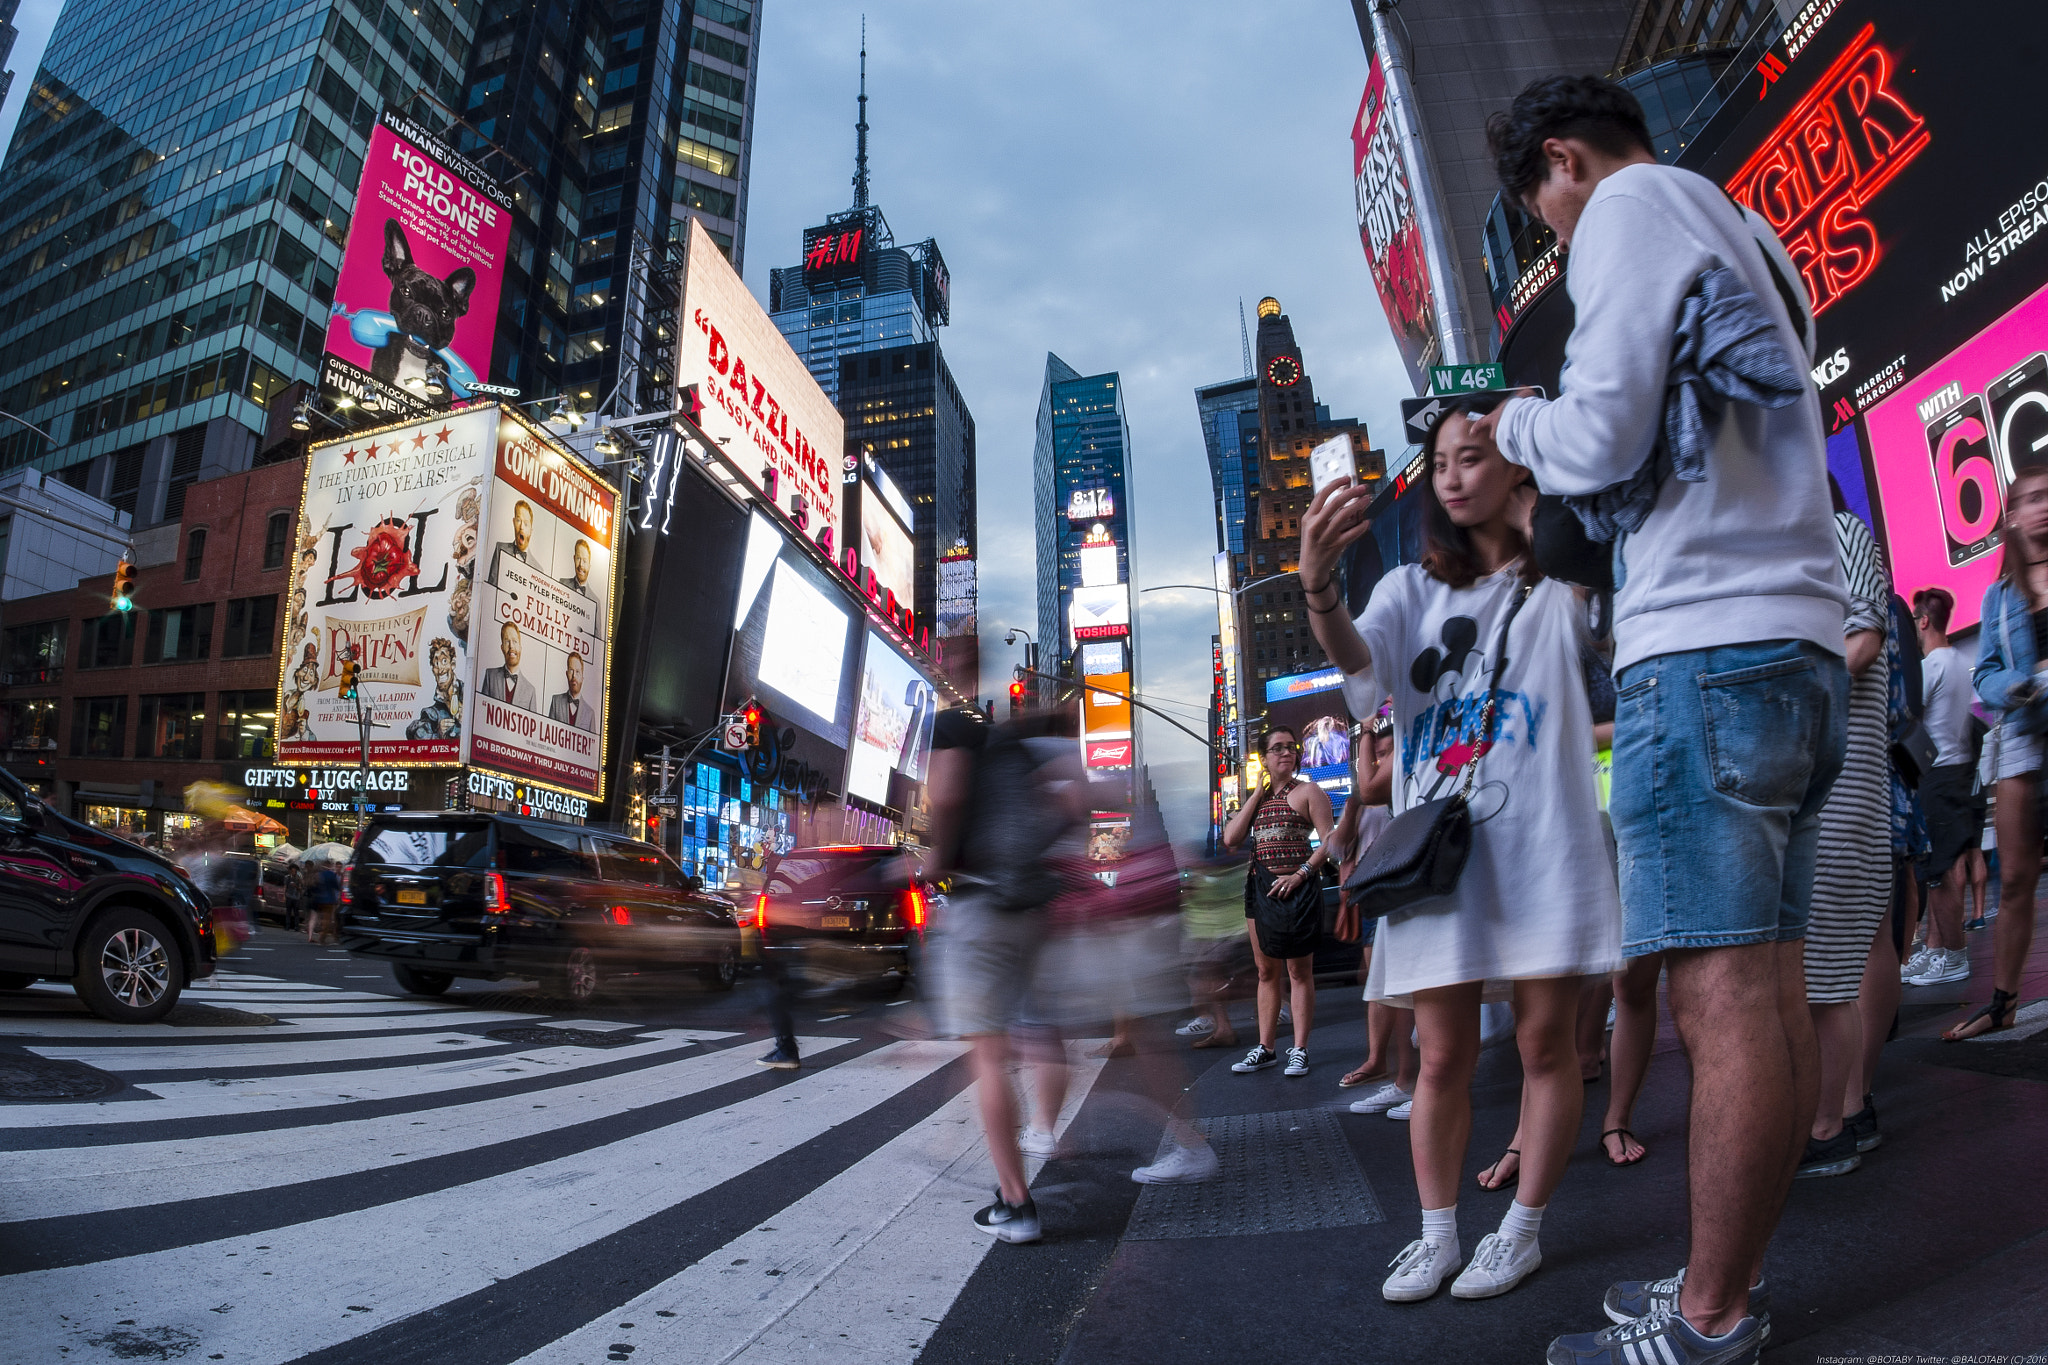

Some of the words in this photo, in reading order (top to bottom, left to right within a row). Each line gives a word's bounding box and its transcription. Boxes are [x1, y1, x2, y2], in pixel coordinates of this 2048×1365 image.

[1788, 0, 1842, 59] MARQUI
[384, 111, 513, 209] HUMANEWATCH.ORG
[405, 117, 420, 130] FIND
[420, 127, 432, 138] OUT
[432, 136, 451, 152] ABOUT
[451, 148, 462, 160] THE
[461, 156, 490, 180] DECEPTION
[392, 142, 454, 195] HOLD
[459, 186, 498, 228] THE
[403, 172, 480, 238] PHONE
[378, 190, 401, 210] States
[402, 207, 418, 221] only
[418, 218, 437, 233] gives
[439, 229, 450, 241] 1%
[450, 237, 459, 246] of
[459, 243, 467, 253] its
[468, 249, 493, 269] millions
[381, 180, 395, 195] The
[396, 191, 425, 215] Humane
[426, 211, 451, 233] Society
[452, 229, 460, 237] of
[460, 234, 472, 246] the
[473, 241, 495, 261] United
[1367, 160, 1409, 260] BOYS
[400, 215, 408, 225] to
[409, 221, 427, 237] local
[427, 234, 440, 246] pet
[440, 242, 471, 265] shelters?
[806, 229, 863, 271] H&M
[1941, 256, 1984, 303] NOW
[1987, 203, 2048, 266] STREA
[1966, 228, 1999, 262] ALL
[1510, 245, 1560, 301] MARRIOTT
[1513, 264, 1557, 315] MARQUIS
[329, 358, 349, 374] GIVE
[349, 367, 362, 380] TO
[1436, 370, 1453, 391] W
[1855, 354, 1906, 397] MARRIOTT
[468, 383, 515, 396] LAMAR
[1857, 371, 1904, 409] MARQUIS
[1919, 382, 1961, 421] WITH
[707, 375, 753, 435] SASSY
[752, 428, 780, 464] AND
[318, 474, 341, 489] THE
[344, 457, 410, 484] FUNNIEST
[413, 442, 477, 469] MUSICAL
[503, 440, 548, 494] COMIC
[559, 462, 592, 495] FERGUSON
[591, 489, 597, 498] IS
[596, 492, 601, 502] A
[842, 472, 857, 484] LG
[336, 485, 353, 505] IN
[358, 480, 387, 500] 400
[1073, 488, 1106, 505] 8:17
[1081, 540, 1116, 549] TOSHIBA
[1086, 533, 1110, 544] 2016
[505, 569, 527, 587] JESSE
[528, 580, 550, 600] TYLER
[551, 592, 586, 618] FERGUSON
[530, 573, 551, 589] MODERN
[550, 584, 570, 599] FAMILY'S
[338, 615, 411, 632] SOMETHING
[501, 602, 590, 656] COMMITTED
[526, 594, 571, 629] FULLY
[1076, 624, 1129, 639] TOSHIBA
[317, 713, 334, 722] THE
[335, 713, 358, 722] BOOK
[373, 710, 414, 721] MORMON
[376, 692, 416, 703] ALADDIN
[374, 745, 396, 754] BTWN
[476, 739, 489, 751] ON
[490, 742, 533, 763] BROADWAY
[533, 756, 553, 769] THRU
[553, 761, 570, 773] JULY
[570, 766, 579, 775] 24
[580, 769, 596, 780] ONLY
[245, 769, 295, 788] GIFTS
[310, 769, 408, 791] LUGGAGE
[469, 772, 514, 801] GIFTS
[525, 786, 588, 818] LUGGAGE
[250, 800, 262, 808] Apple
[321, 802, 350, 811] SONY
